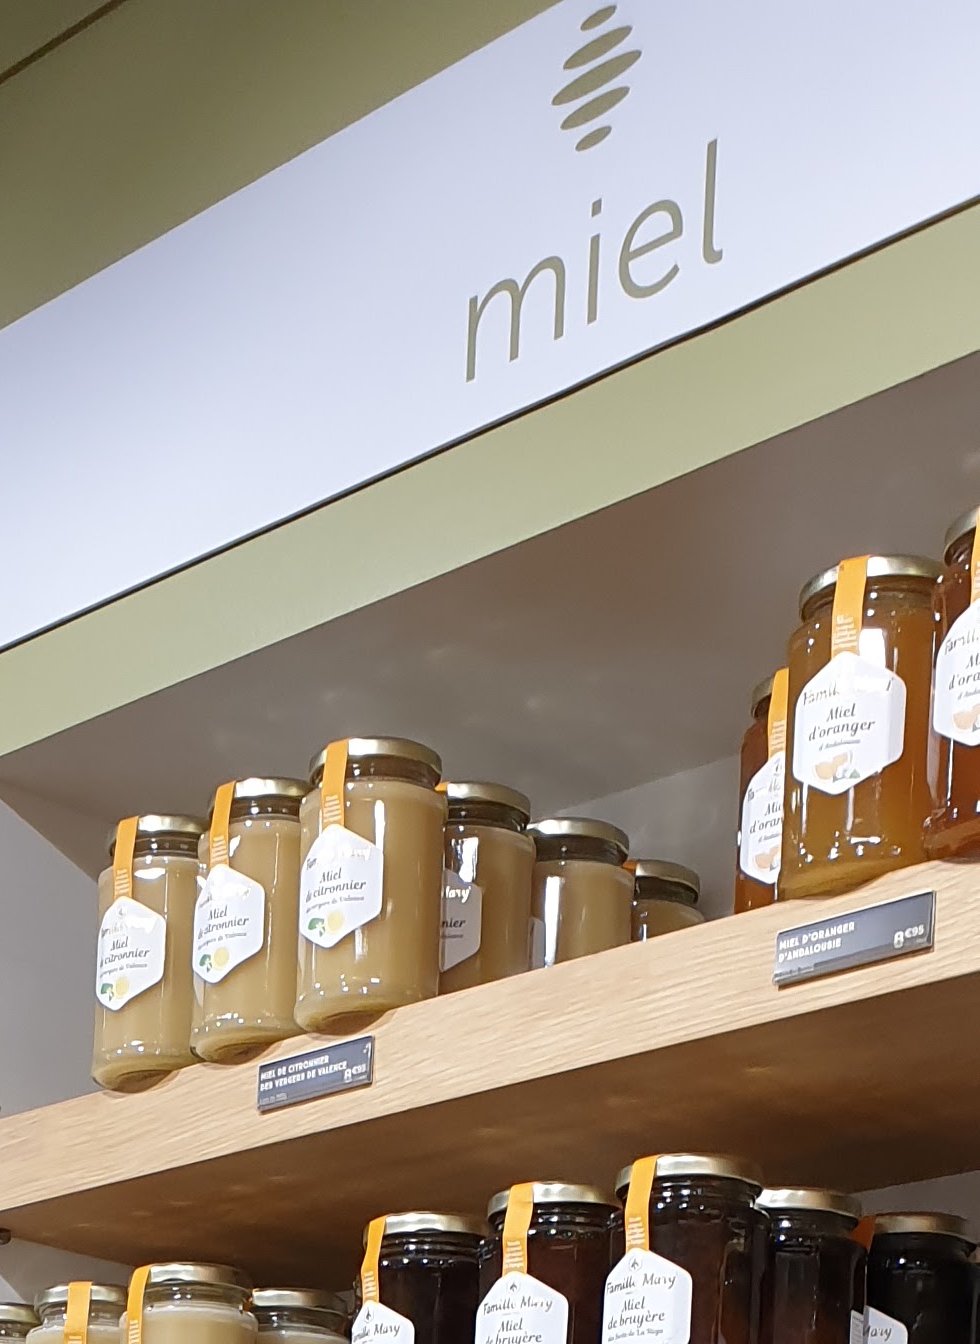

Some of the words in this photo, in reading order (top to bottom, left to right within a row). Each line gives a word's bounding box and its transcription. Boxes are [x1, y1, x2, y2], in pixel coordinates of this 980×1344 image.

[466, 138, 723, 383] miel
[826, 702, 856, 723] Miel
[808, 718, 876, 741] d'oranger
[319, 868, 342, 884] Miel
[314, 879, 366, 897] citronnier
[779, 935, 799, 950] MIEL
[801, 921, 855, 944] D'ORANGER
[260, 1070, 275, 1080] MIEL
[619, 1310, 665, 1329] bruyère
